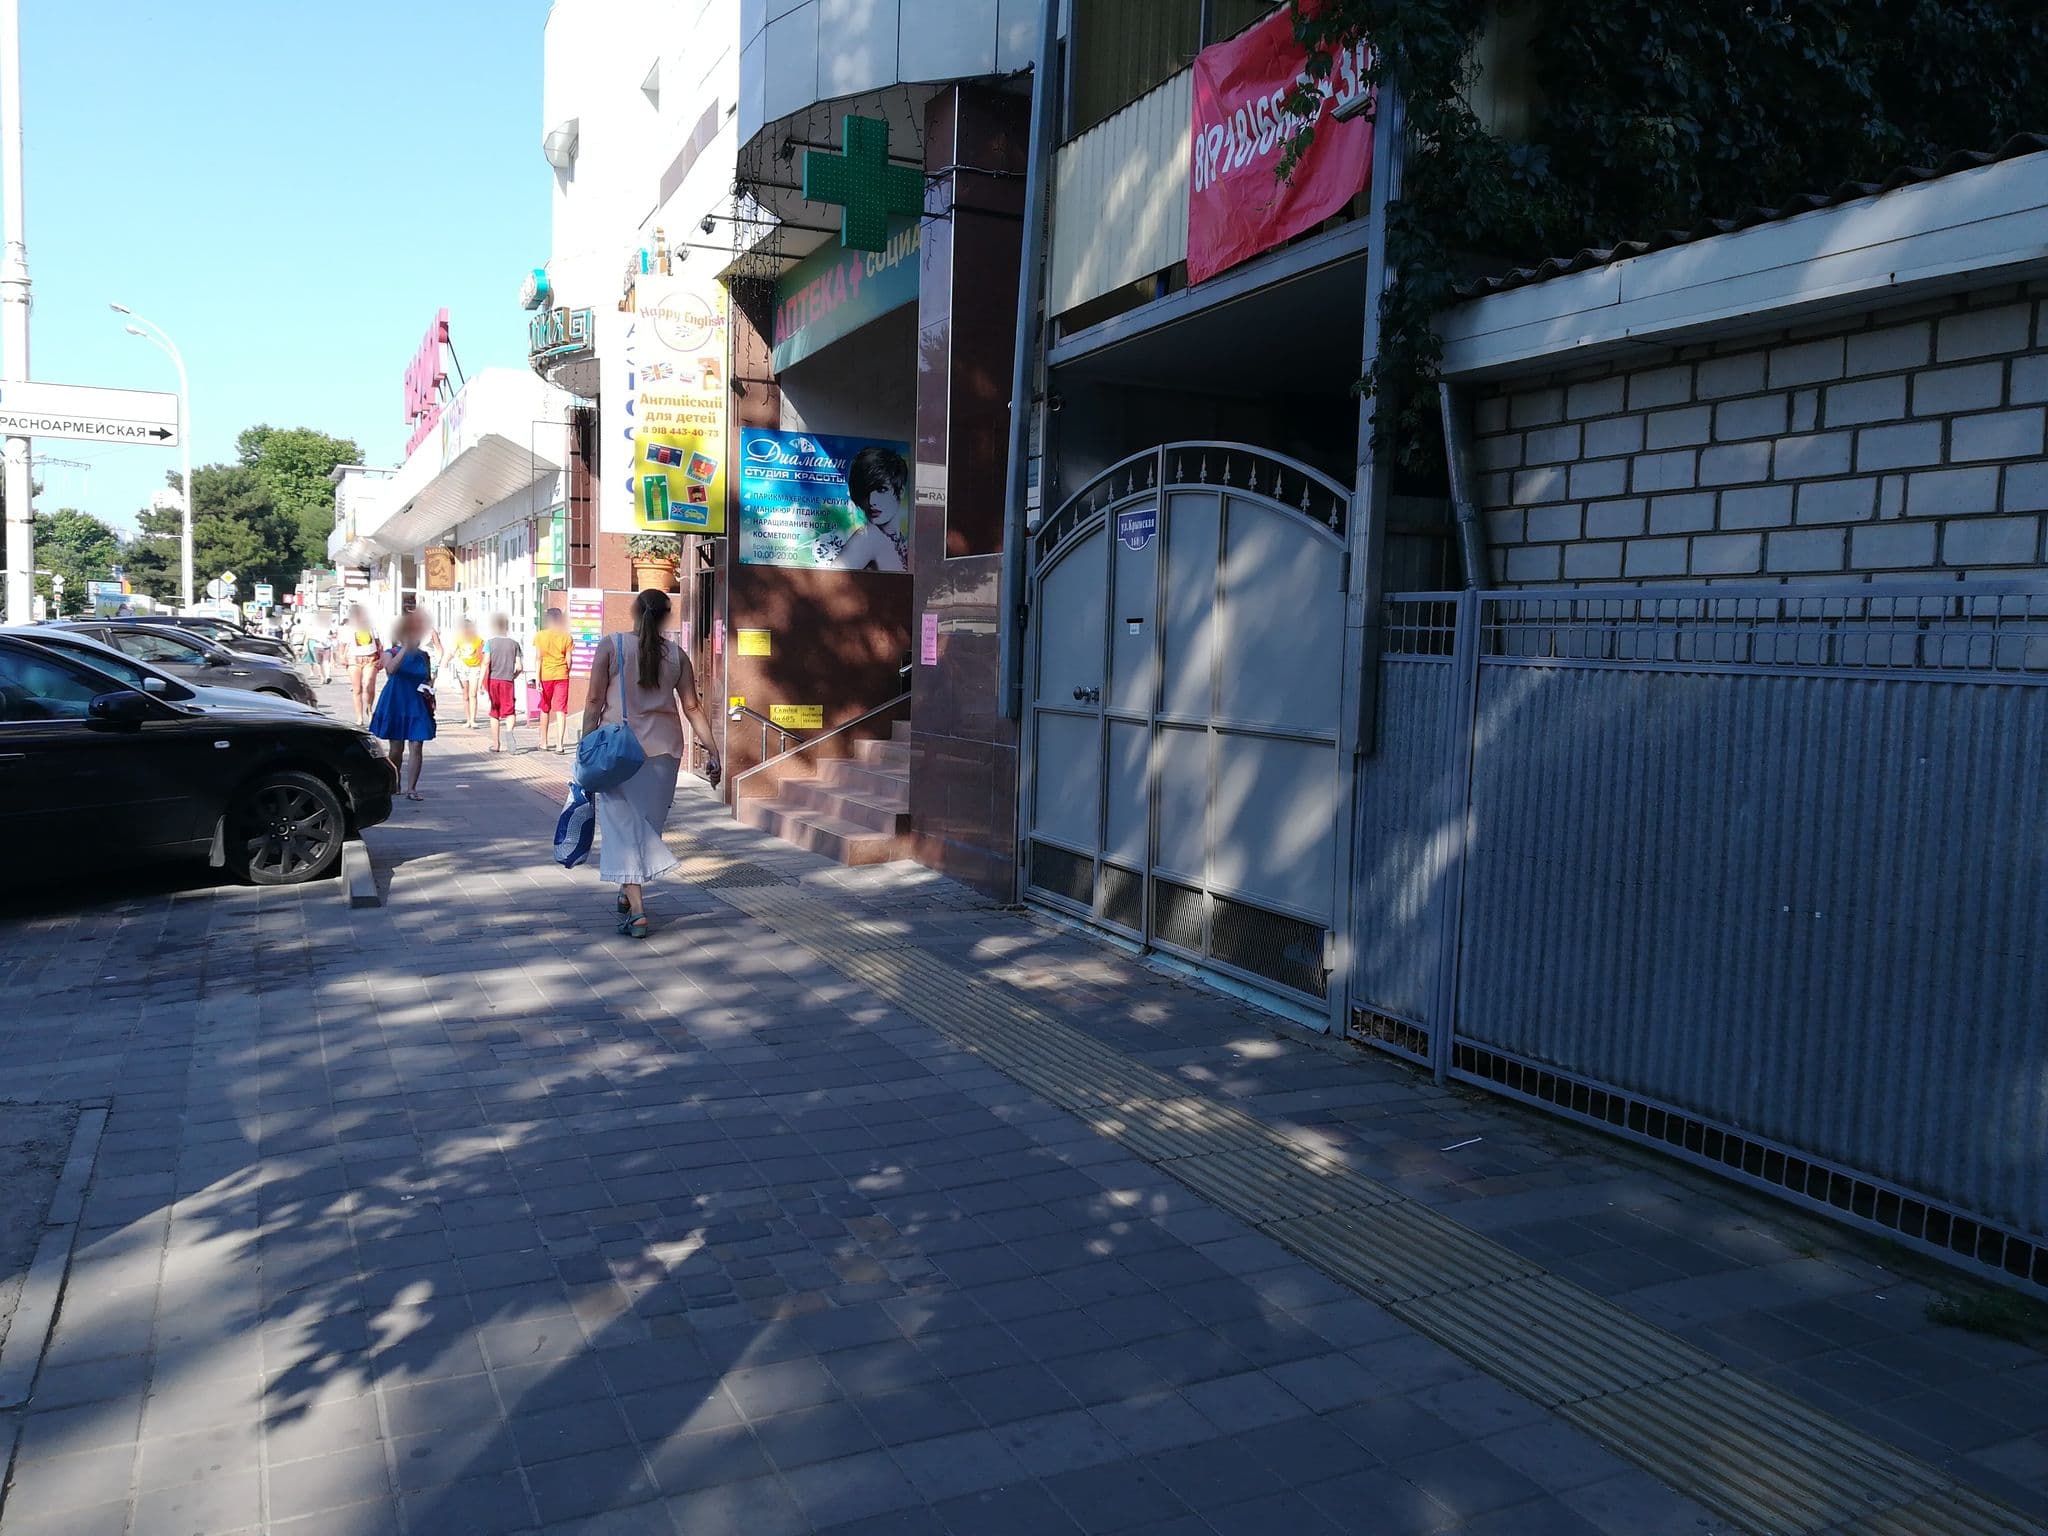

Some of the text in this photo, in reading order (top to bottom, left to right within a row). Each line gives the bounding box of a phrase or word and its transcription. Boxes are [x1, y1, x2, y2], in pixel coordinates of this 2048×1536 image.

[775, 262, 847, 344] АПТЕКА
[640, 305, 726, 329] Happy English
[639, 392, 723, 409] Английский
[645, 411, 717, 424] для детей
[651, 426, 668, 434] 918
[744, 438, 847, 469] Диамант
[744, 469, 846, 483] СТУДИЯ КРАСОТЫ
[753, 492, 820, 503] ПАРИКМАХЕРСКИЕ
[754, 505, 791, 514] МАНИКЮР
[796, 508, 831, 517] ПЕДИКЮР
[753, 518, 809, 529] НАРАЩИВАНИЕ
[752, 531, 800, 541] КОСМЕТОЛОГ
